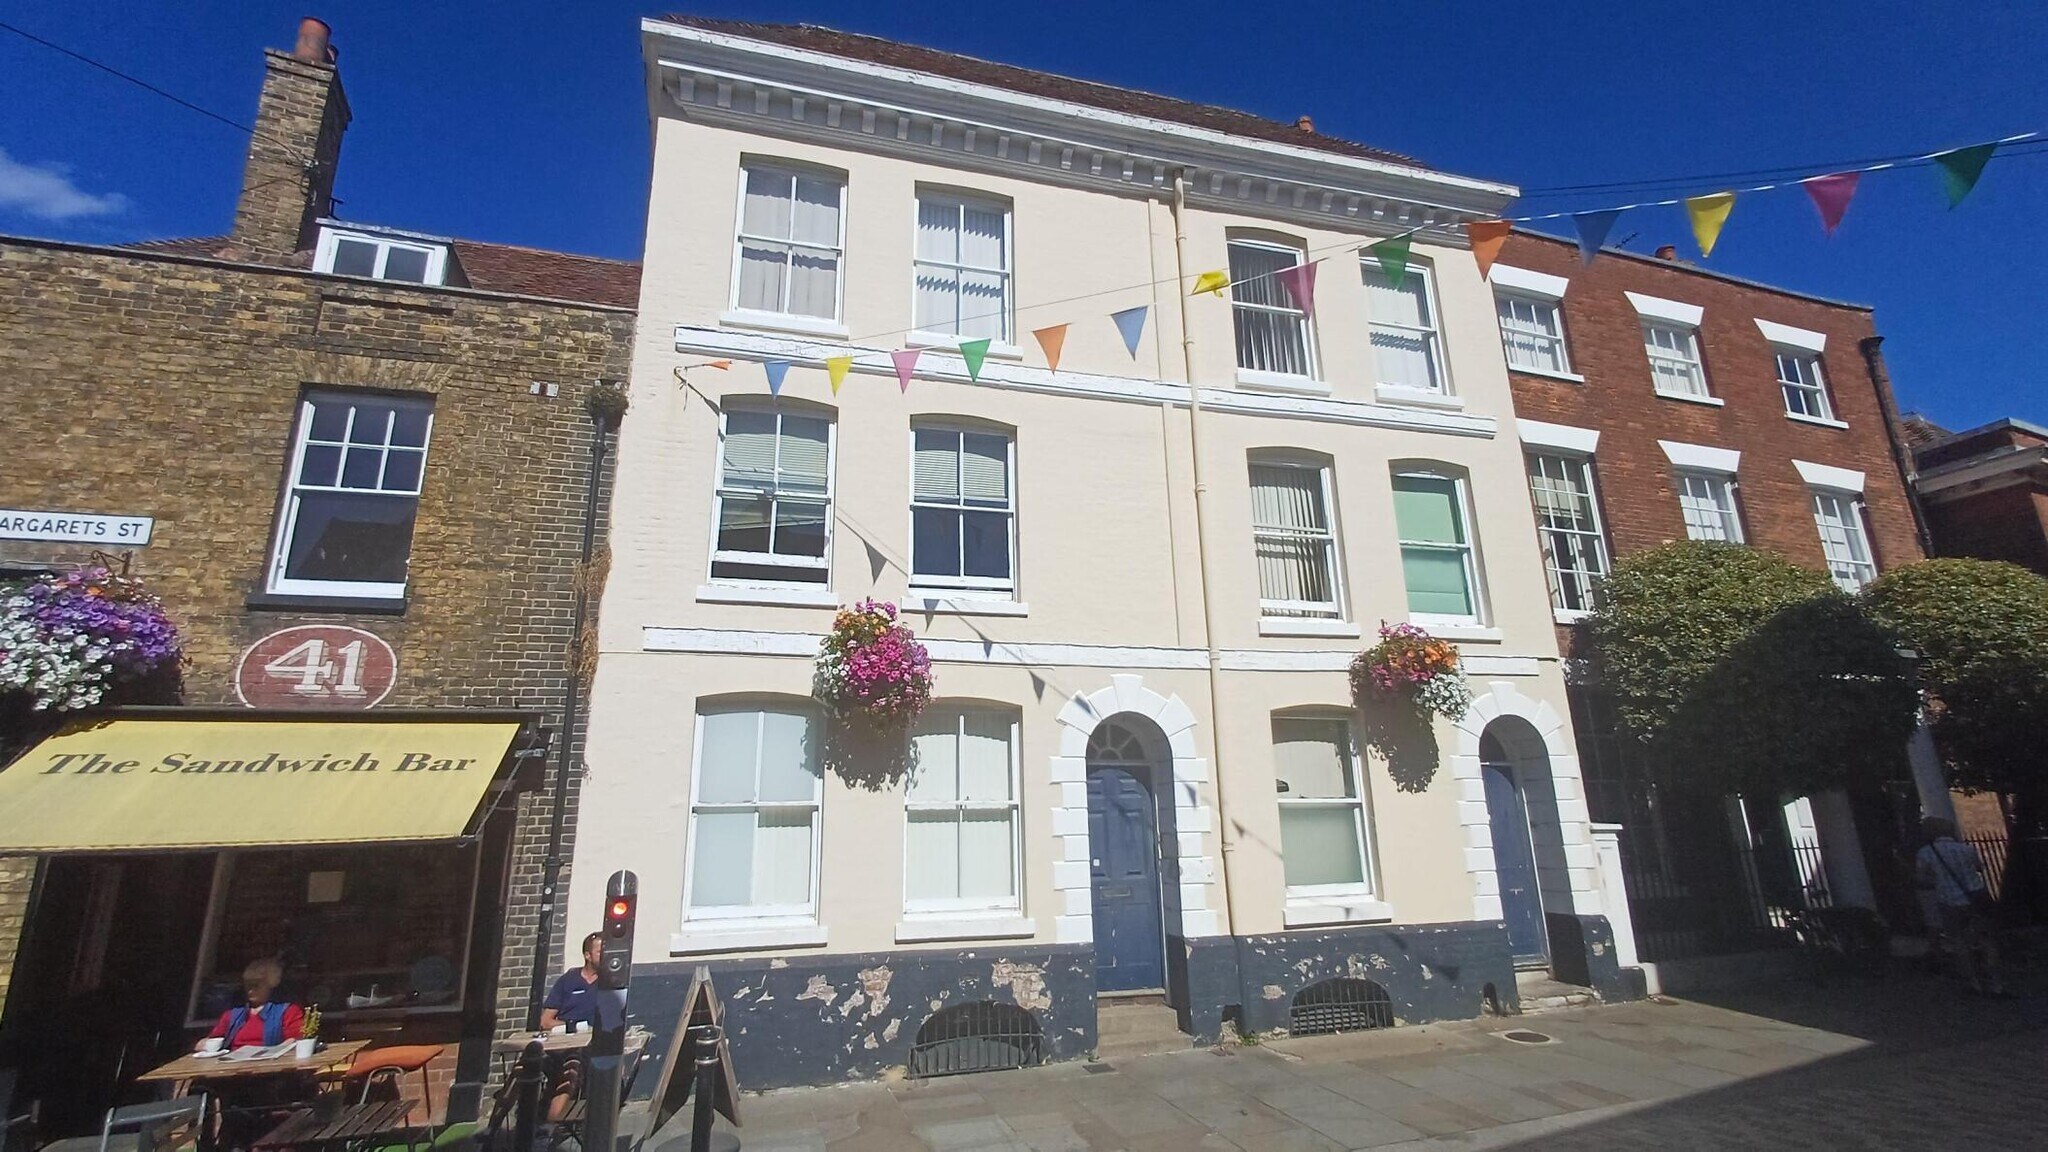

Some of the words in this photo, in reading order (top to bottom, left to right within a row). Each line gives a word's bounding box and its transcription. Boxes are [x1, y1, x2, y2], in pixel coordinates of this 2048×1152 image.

[0, 517, 107, 536] ARGARETS
[117, 523, 144, 537] ST
[264, 639, 366, 695] 41
[39, 753, 141, 774] The
[150, 752, 381, 774] Sandwich
[392, 752, 477, 772] Bar
